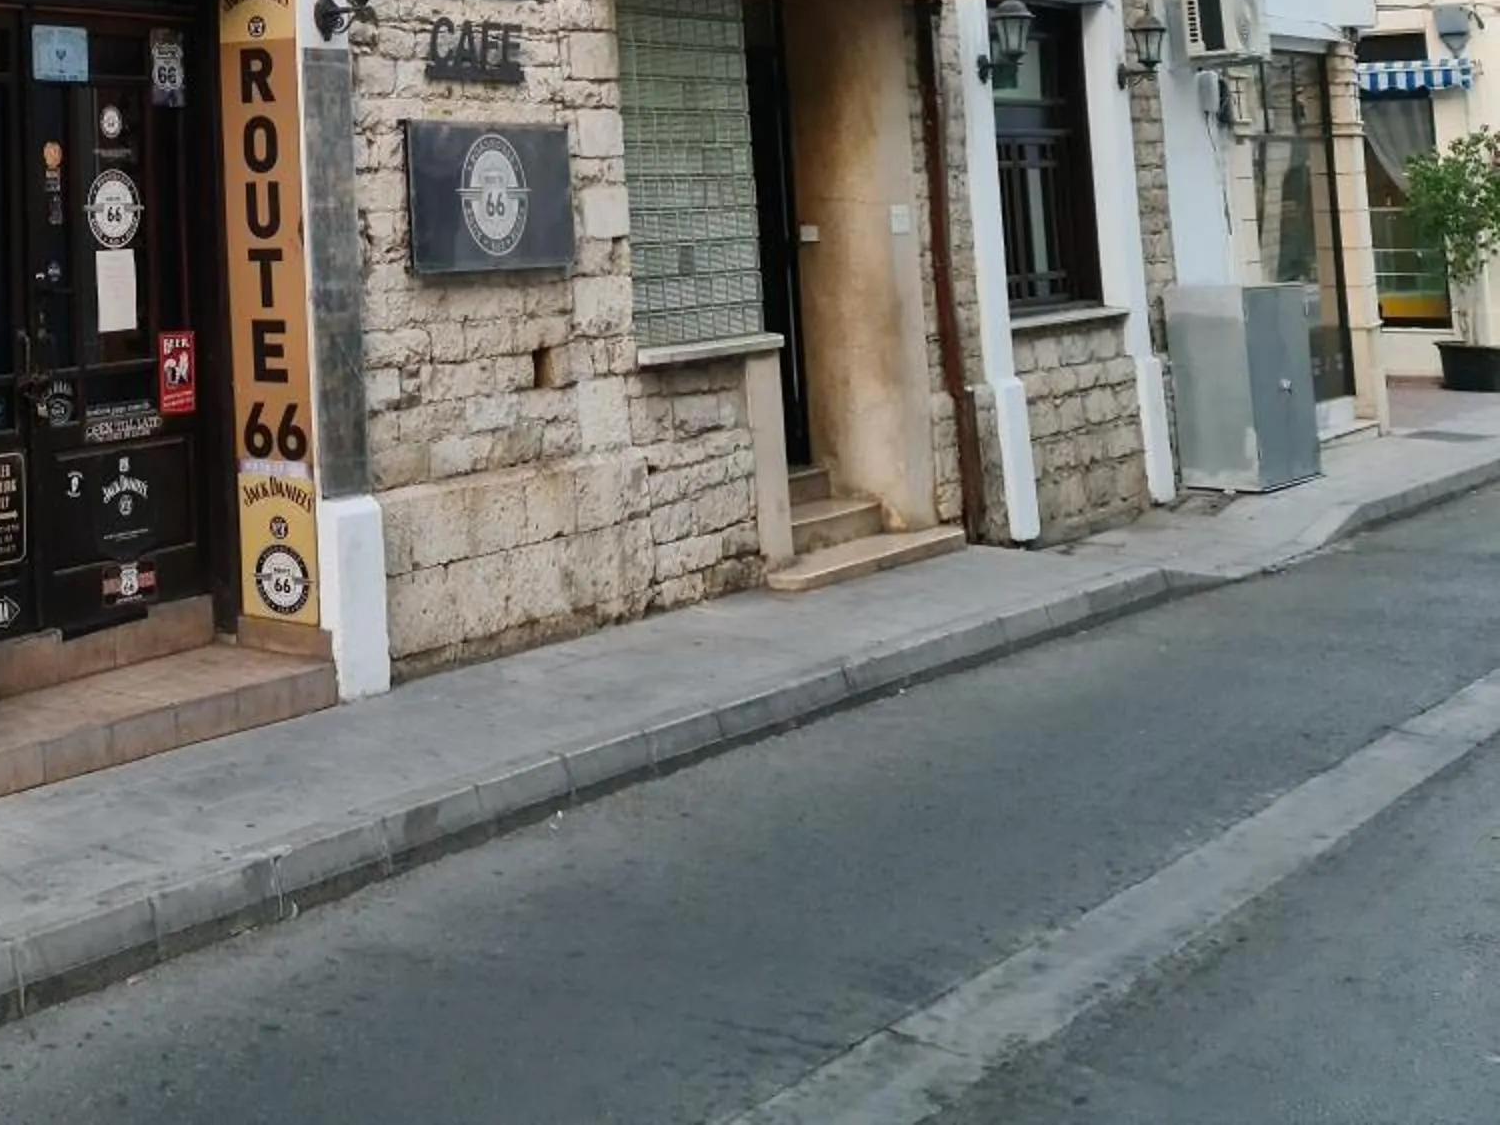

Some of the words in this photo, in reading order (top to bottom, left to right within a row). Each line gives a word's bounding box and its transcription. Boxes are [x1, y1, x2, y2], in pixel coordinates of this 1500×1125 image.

[429, 16, 522, 74] CAFE
[107, 206, 122, 222] 66
[240, 47, 289, 384] ROUTE
[485, 191, 505, 217] 66
[244, 401, 307, 461] 66
[243, 481, 269, 507] JACK
[274, 578, 291, 594] 66
